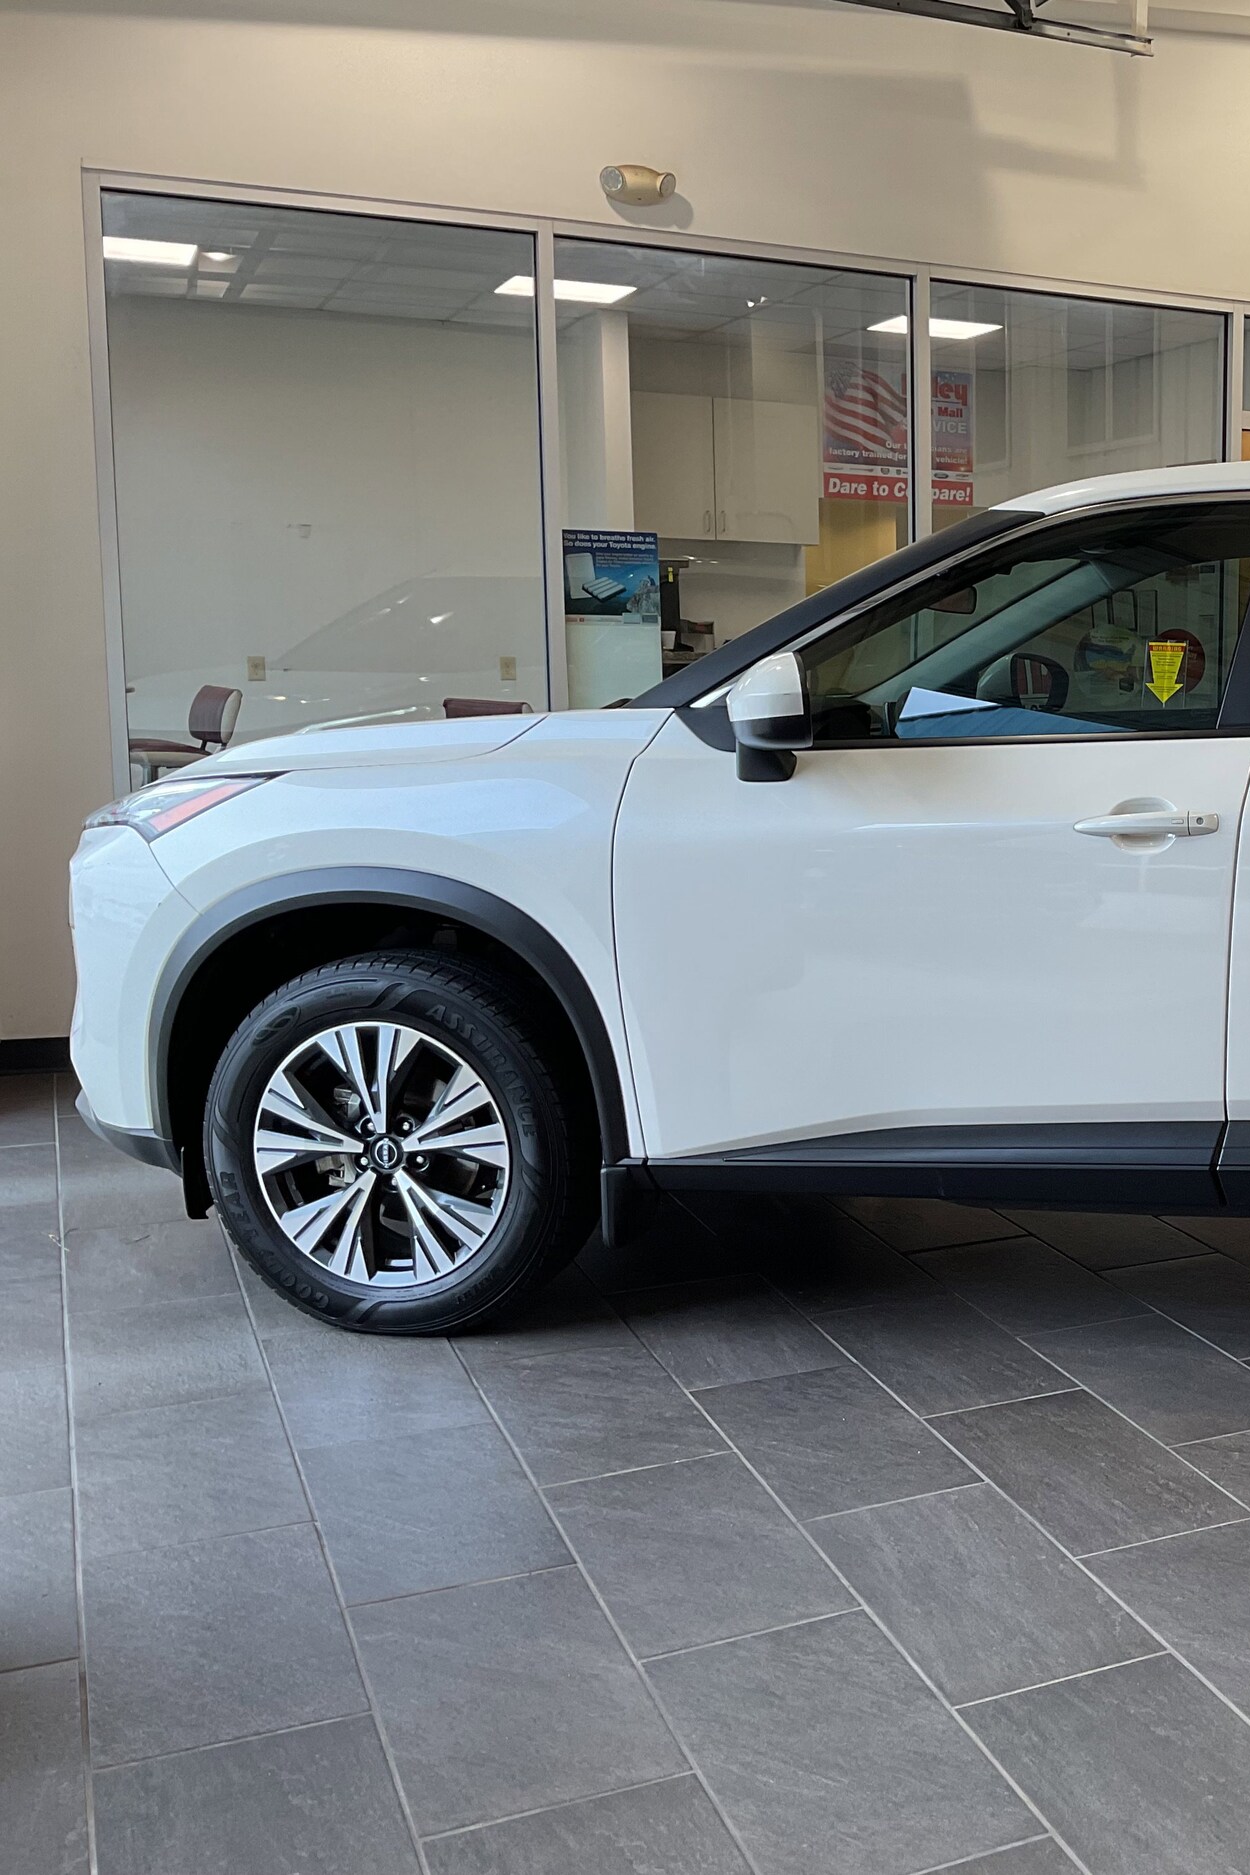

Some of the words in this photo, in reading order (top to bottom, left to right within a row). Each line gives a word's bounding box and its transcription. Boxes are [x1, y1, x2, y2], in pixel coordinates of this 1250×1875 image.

[901, 373, 968, 406] ley
[938, 406, 963, 418] Mall
[885, 441, 901, 449] Our
[829, 447, 860, 458] factory
[862, 450, 893, 460] trained
[829, 478, 867, 495] Dare
[872, 481, 889, 496] to
[893, 482, 970, 502] Cpare!
[563, 532, 576, 540] You
[599, 534, 626, 542] breathe
[574, 540, 591, 548] does
[592, 542, 608, 550] your
[609, 541, 632, 550] Toyota
[424, 1003, 537, 1137] ASSURANCE
